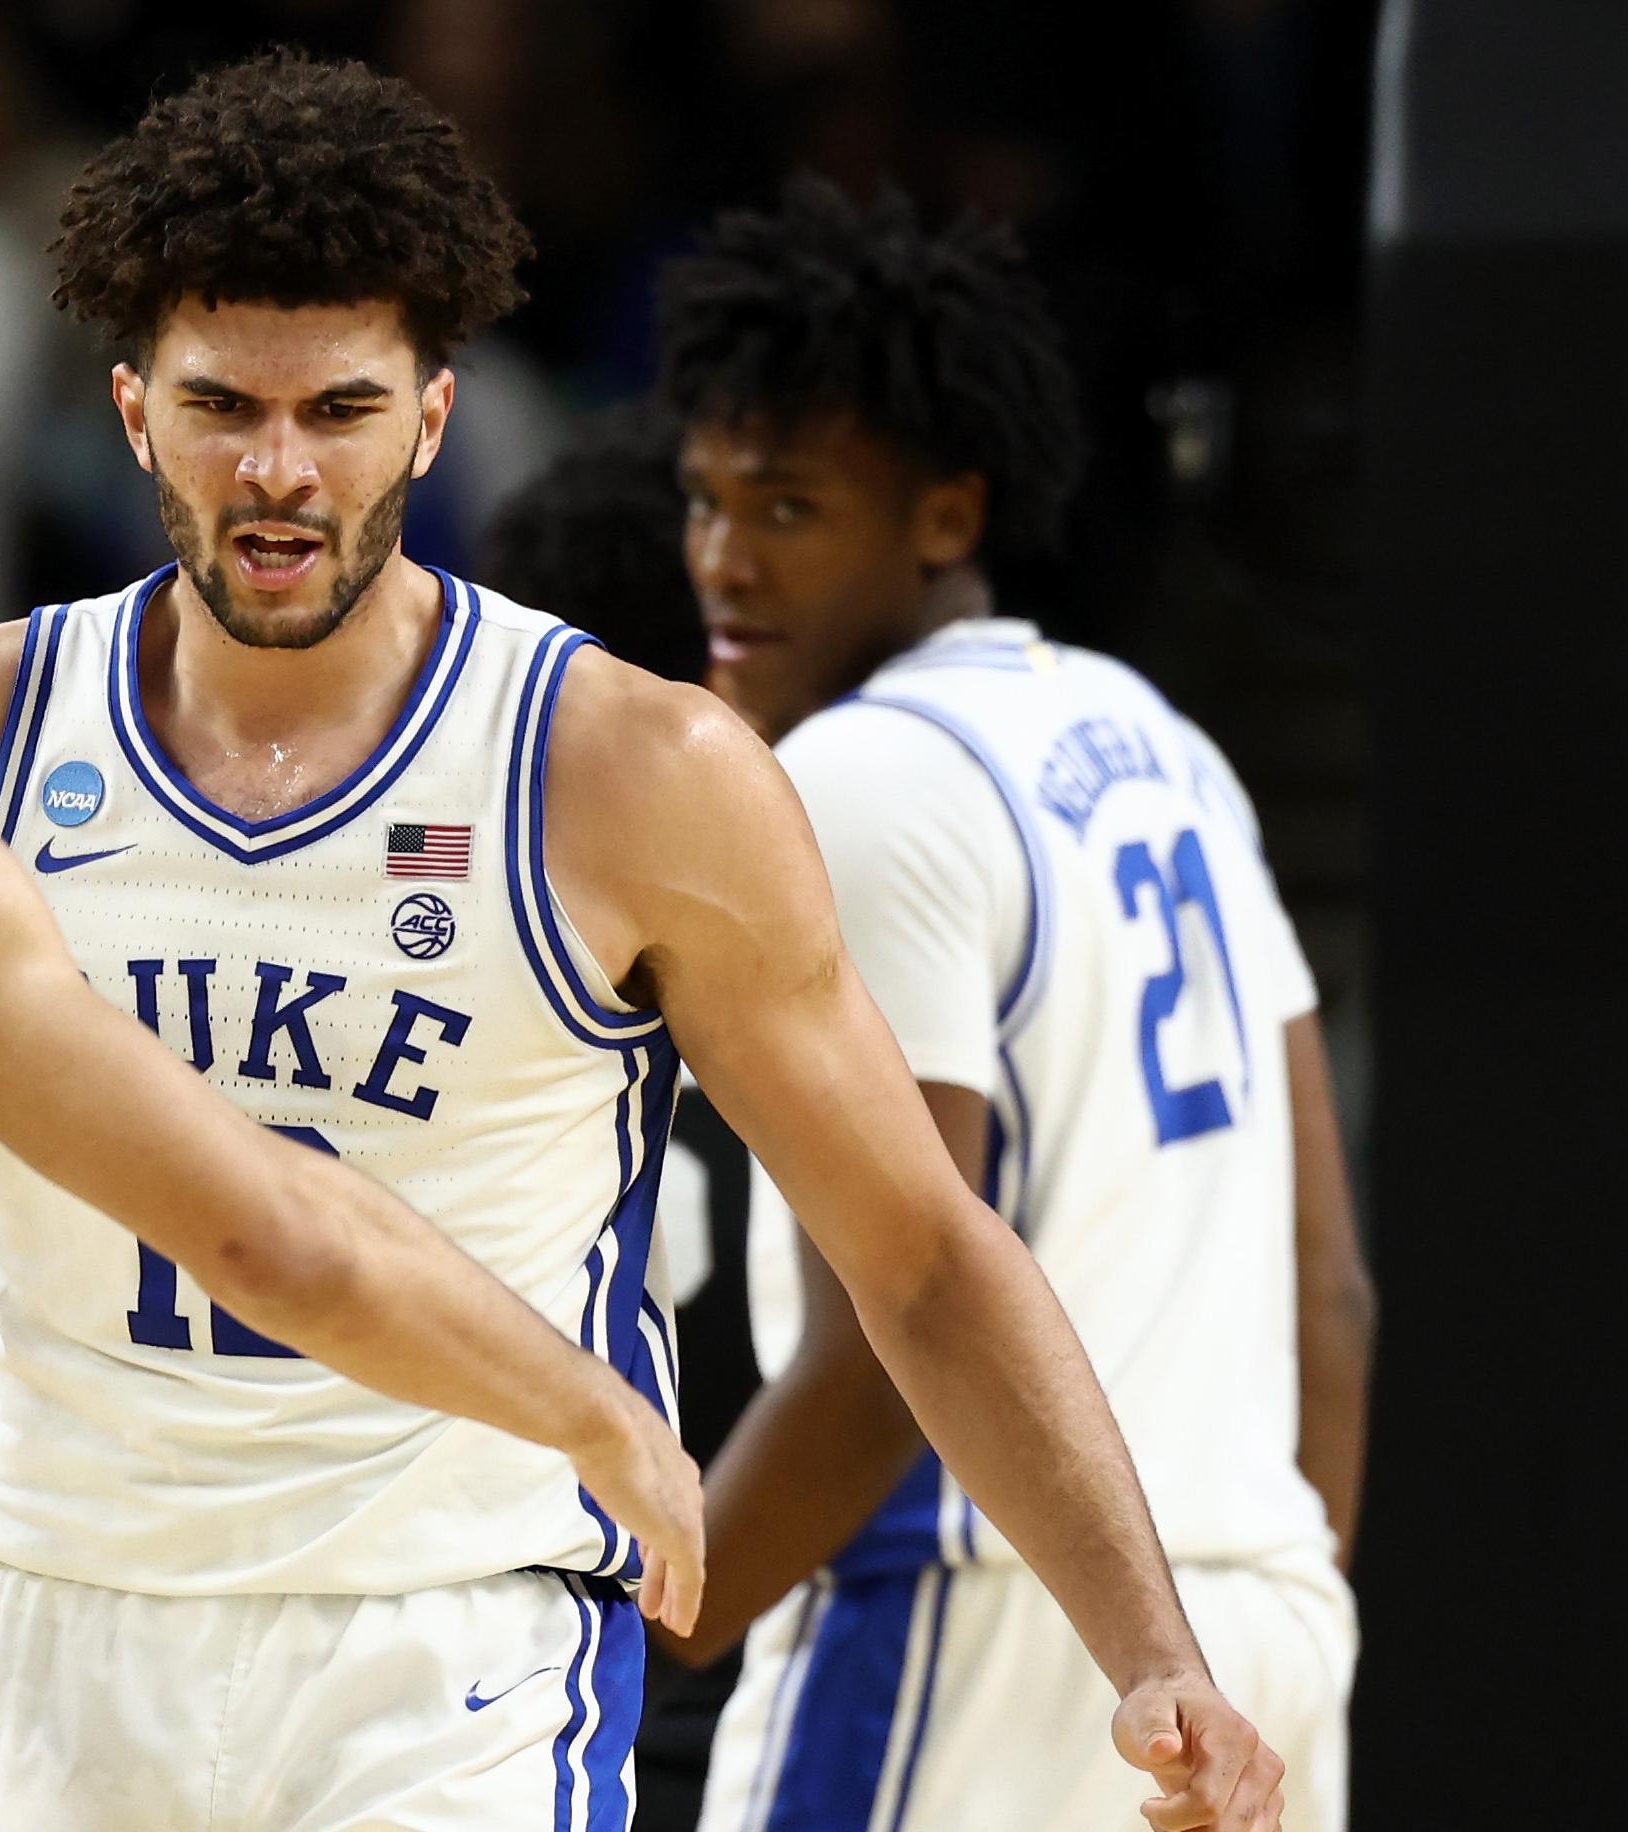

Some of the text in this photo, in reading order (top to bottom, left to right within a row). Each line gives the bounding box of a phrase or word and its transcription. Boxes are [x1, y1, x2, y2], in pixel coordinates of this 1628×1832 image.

[47, 790, 98, 812] NCAA
[400, 914, 453, 936] ACC
[80, 958, 473, 1121] UKE
